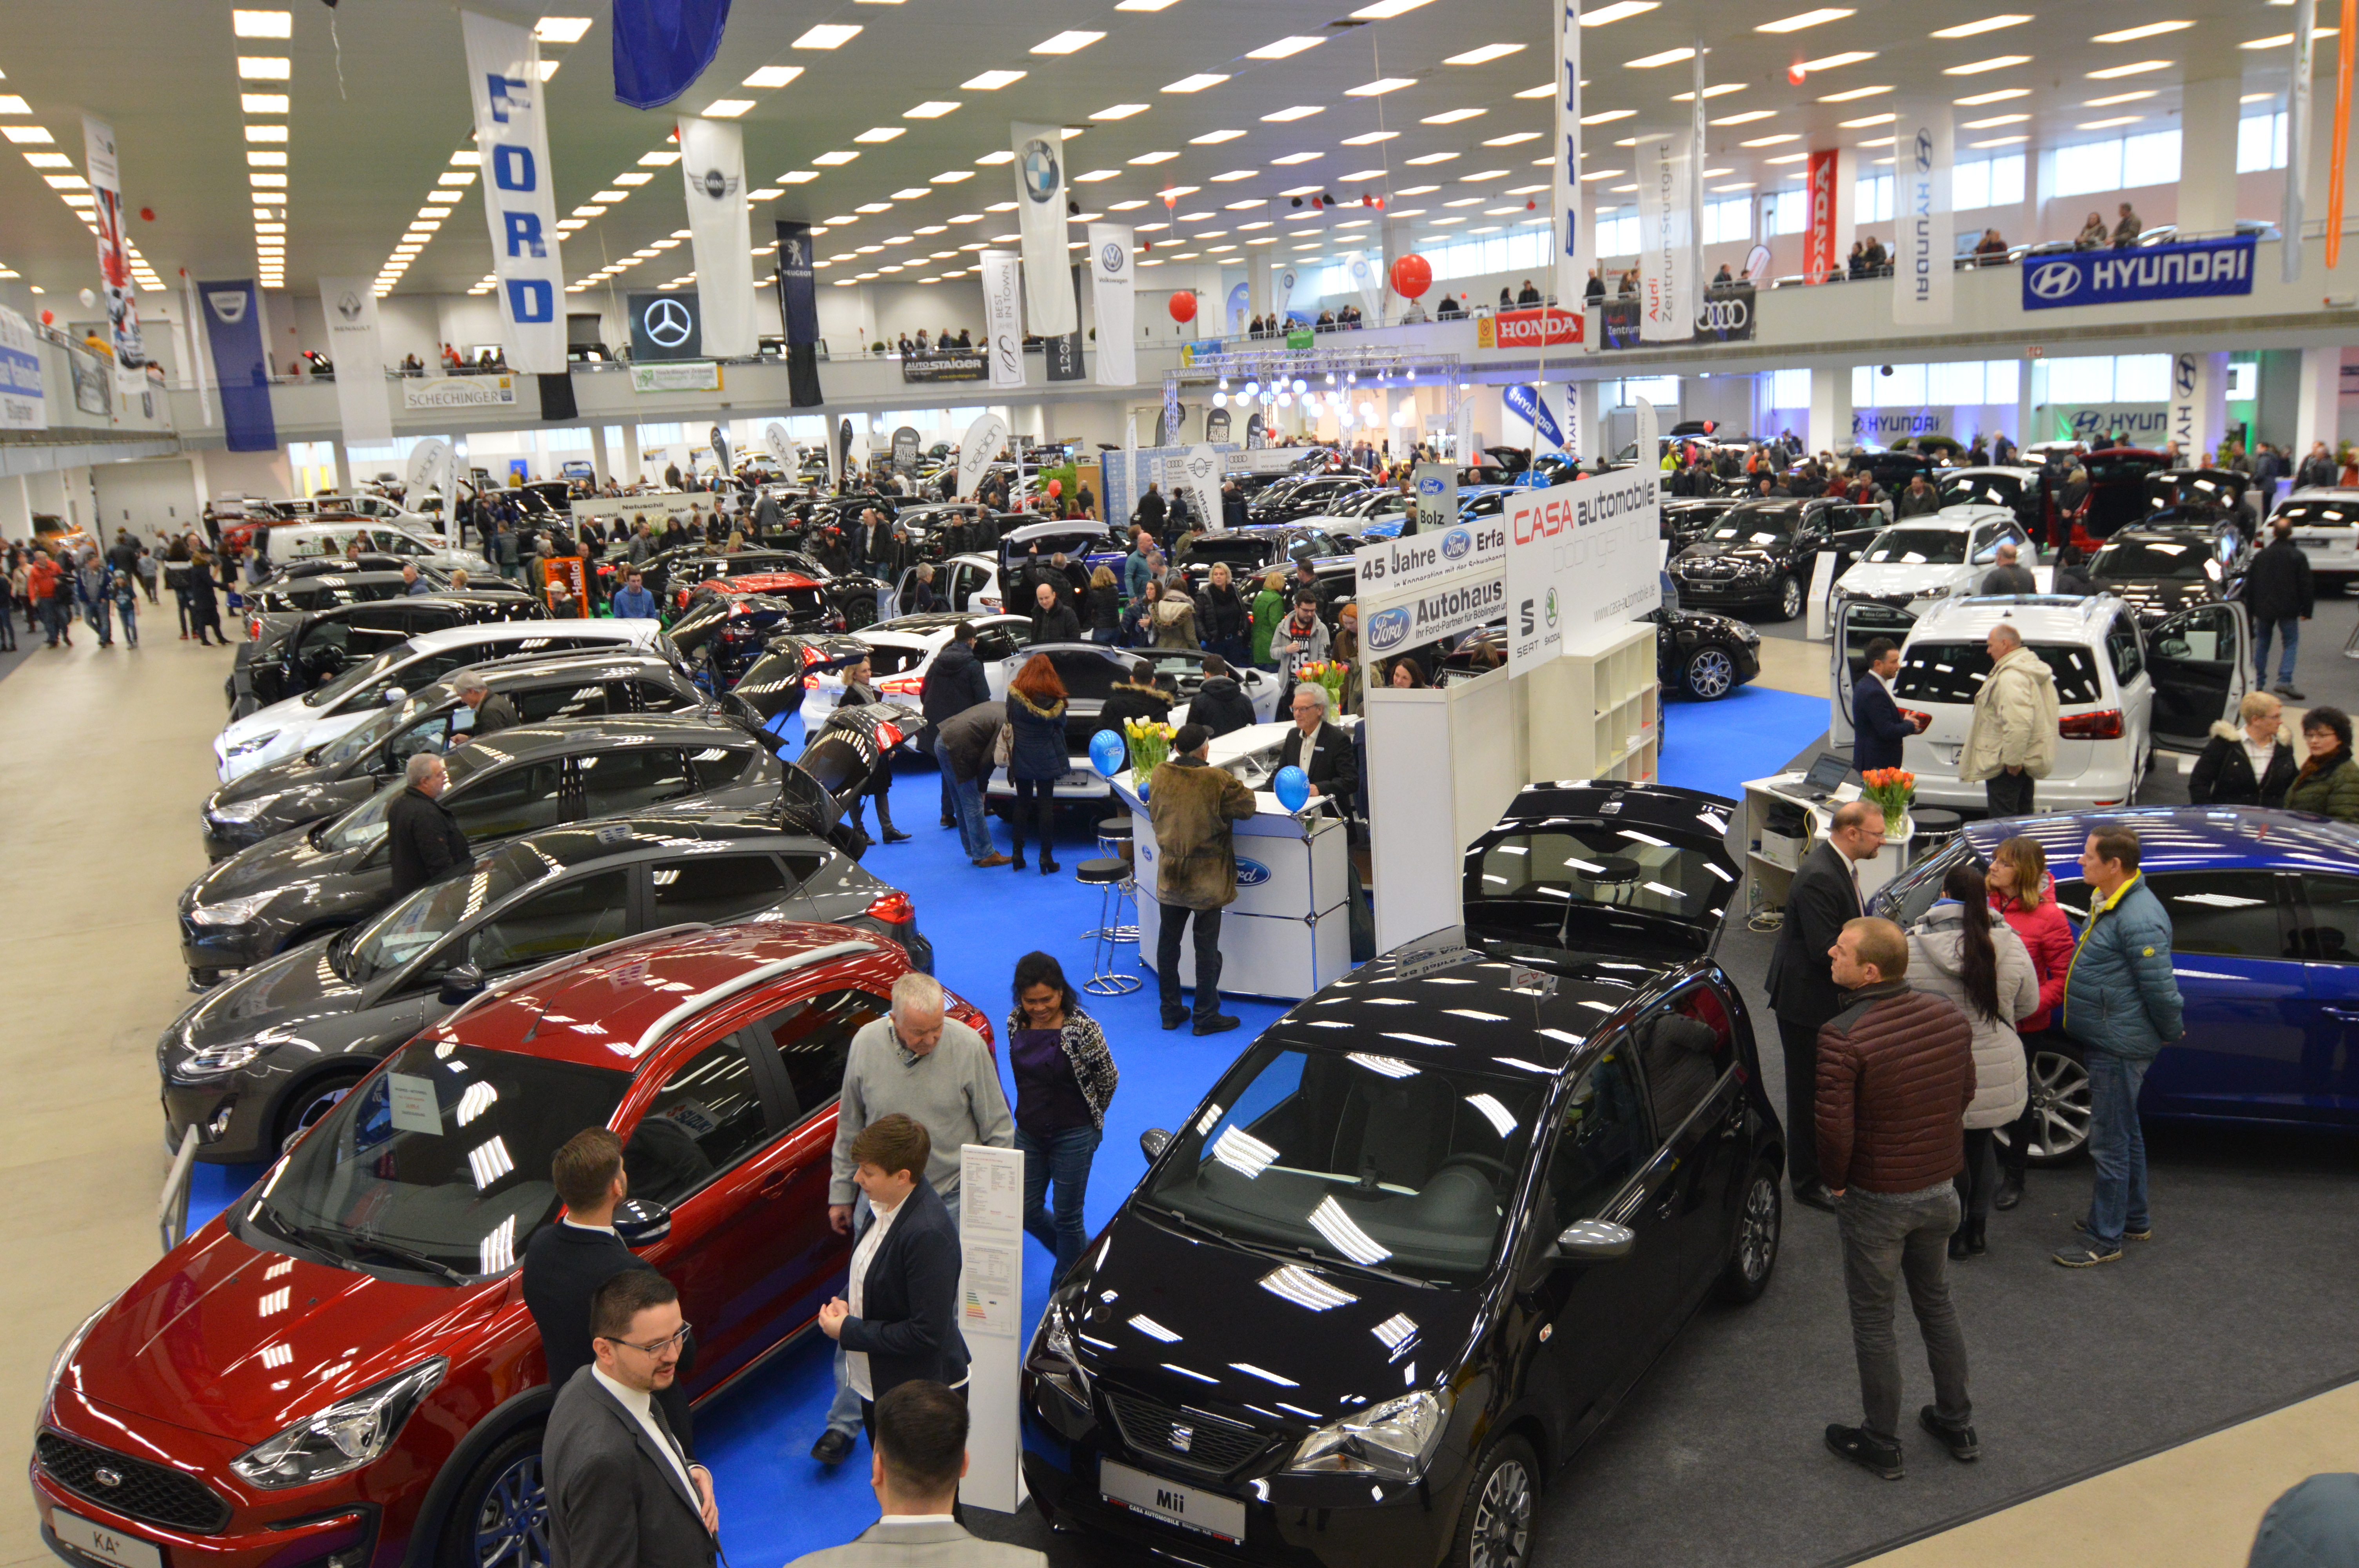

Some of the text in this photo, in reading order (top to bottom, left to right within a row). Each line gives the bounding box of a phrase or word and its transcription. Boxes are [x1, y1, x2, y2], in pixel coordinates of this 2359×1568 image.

[487, 73, 553, 323] FORD
[706, 179, 724, 189] MINI
[1661, 143, 1674, 322] Zentrum Stuttgart
[1812, 158, 1830, 283] ONDA
[1916, 183, 1930, 302] HYUNDAI
[2093, 249, 2248, 290] HYUNDAI
[994, 294, 1003, 318] BEST
[1002, 265, 1012, 318] IN TOWN
[1649, 278, 1658, 322] Audi
[1500, 316, 1578, 338] HONDA
[1608, 325, 1640, 335] Zentrum
[409, 391, 498, 406] SCHECHINGER
[1869, 416, 1939, 432] HYUNDAI
[2110, 412, 2168, 432] HYUN
[965, 423, 1001, 472] bebion
[1421, 479, 1438, 492] Ford
[668, 505, 709, 513] Netuhil
[1421, 510, 1445, 525] Bolz
[1514, 478, 1654, 545] CASA automobile
[1361, 528, 1504, 581] 45 Jahre Ford Erfa
[570, 560, 583, 596] Hallo!
[1416, 581, 1502, 626] Autohaus
[1372, 612, 1403, 645] Ford
[1416, 630, 1424, 639] Ihr
[1425, 617, 1463, 636] Ford-Partner
[1474, 604, 1500, 619] Böblingen
[1517, 639, 1539, 658] SEAT
[1545, 632, 1560, 646] ŠKODA
[1129, 1504, 1143, 1514] CASA
[1144, 1510, 1179, 1526] AUTOMOBILE
[1156, 1488, 1184, 1513] Mii
